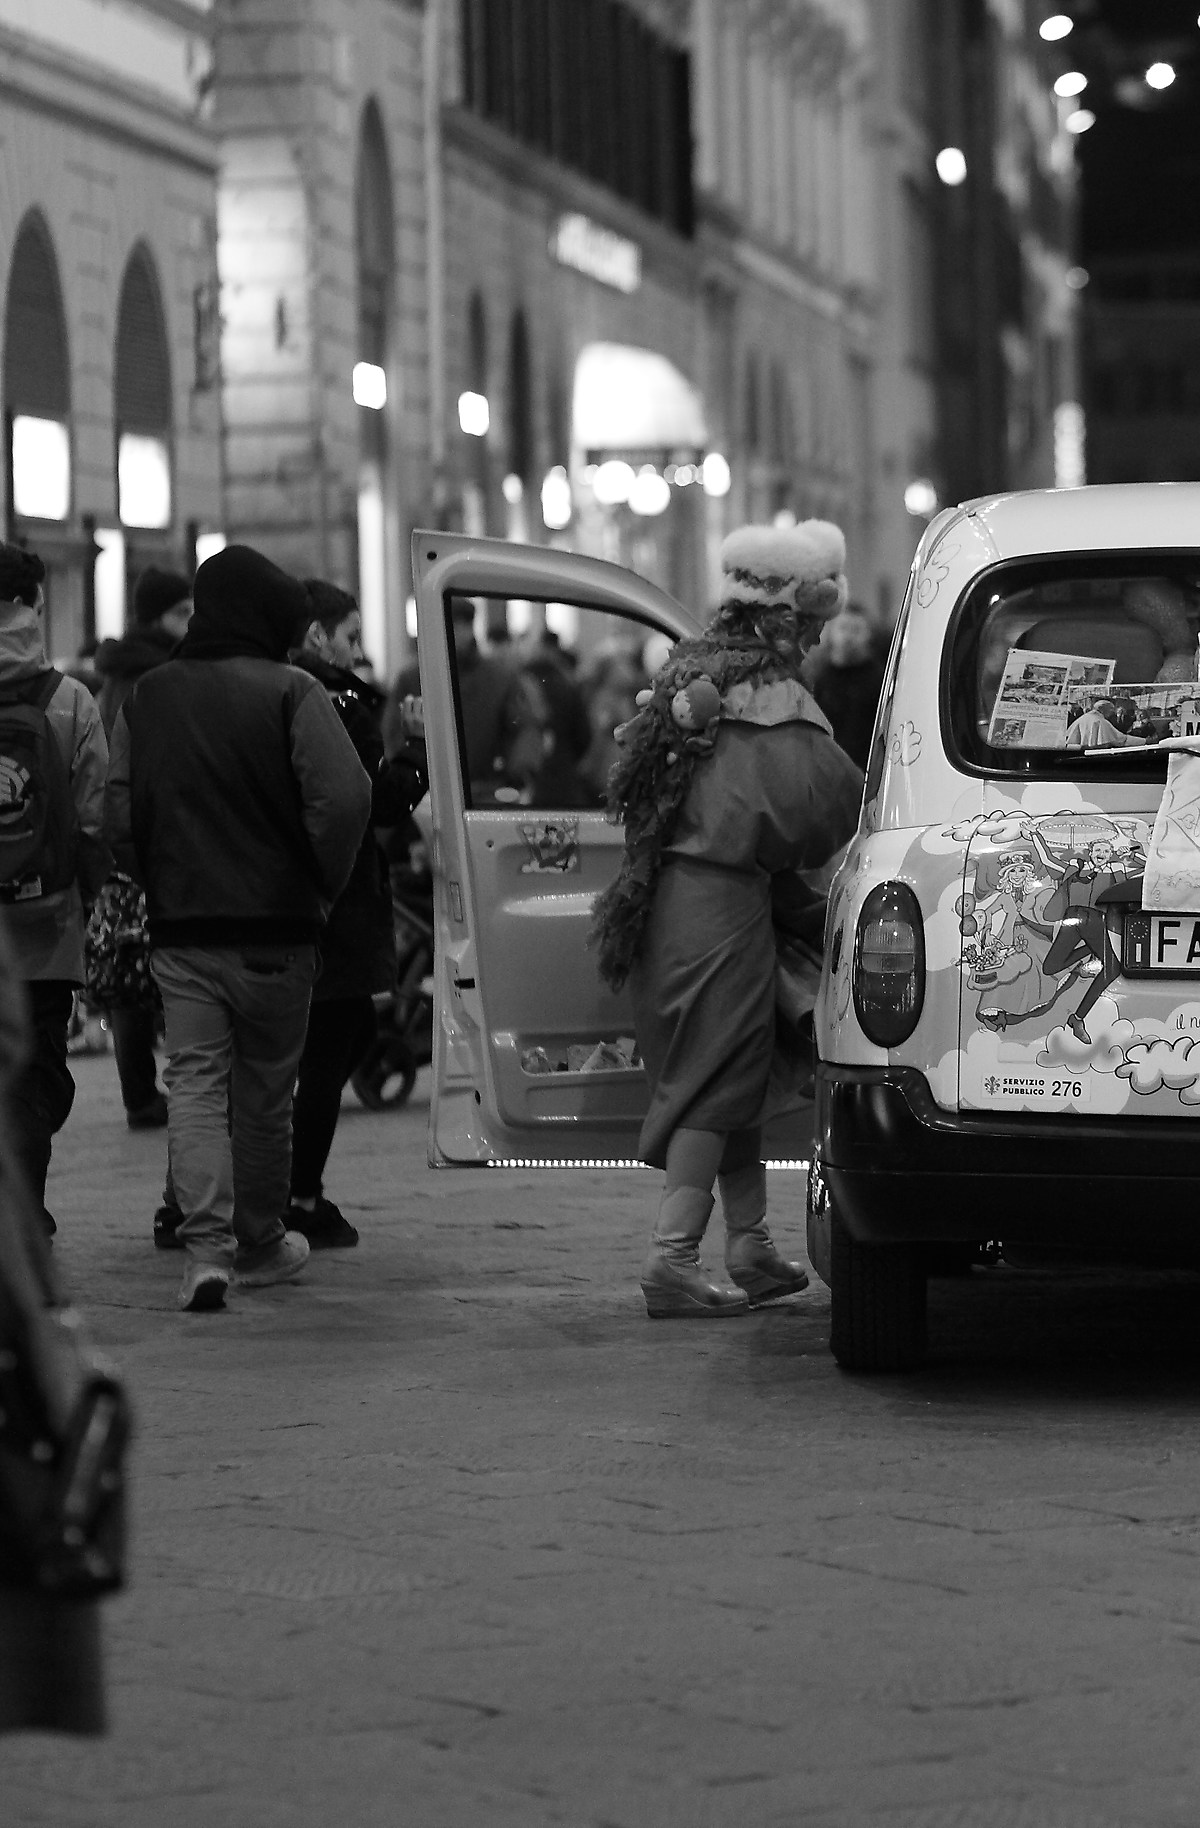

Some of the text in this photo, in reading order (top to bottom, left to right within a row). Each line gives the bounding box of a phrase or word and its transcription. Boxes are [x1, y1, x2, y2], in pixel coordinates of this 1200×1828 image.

[1003, 1078, 1045, 1086] SERVIZIO
[1002, 1087, 1045, 1096] PUBBLICO
[1051, 1080, 1082, 1097] 276
